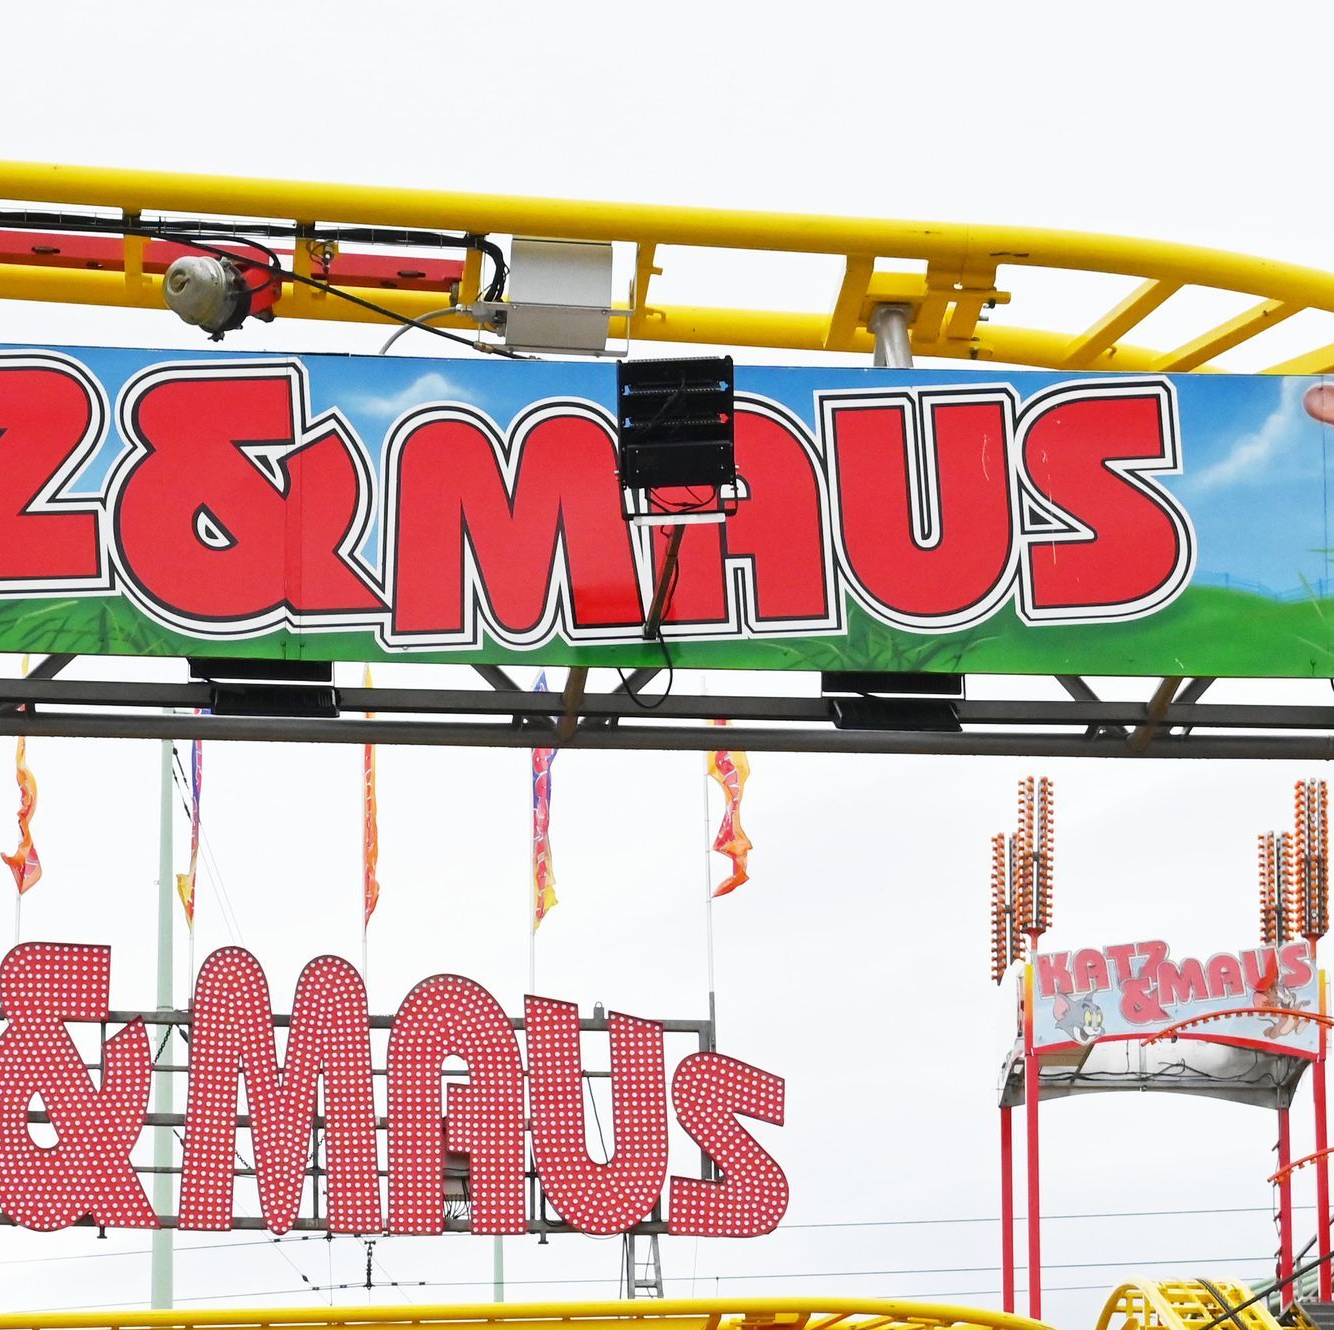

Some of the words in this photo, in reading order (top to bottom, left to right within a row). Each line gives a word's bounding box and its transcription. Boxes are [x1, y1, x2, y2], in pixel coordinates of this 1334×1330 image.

[1036, 940, 1170, 999] KATZ
[1120, 976, 1174, 1026] &
[1157, 942, 1318, 1006] MAUS
